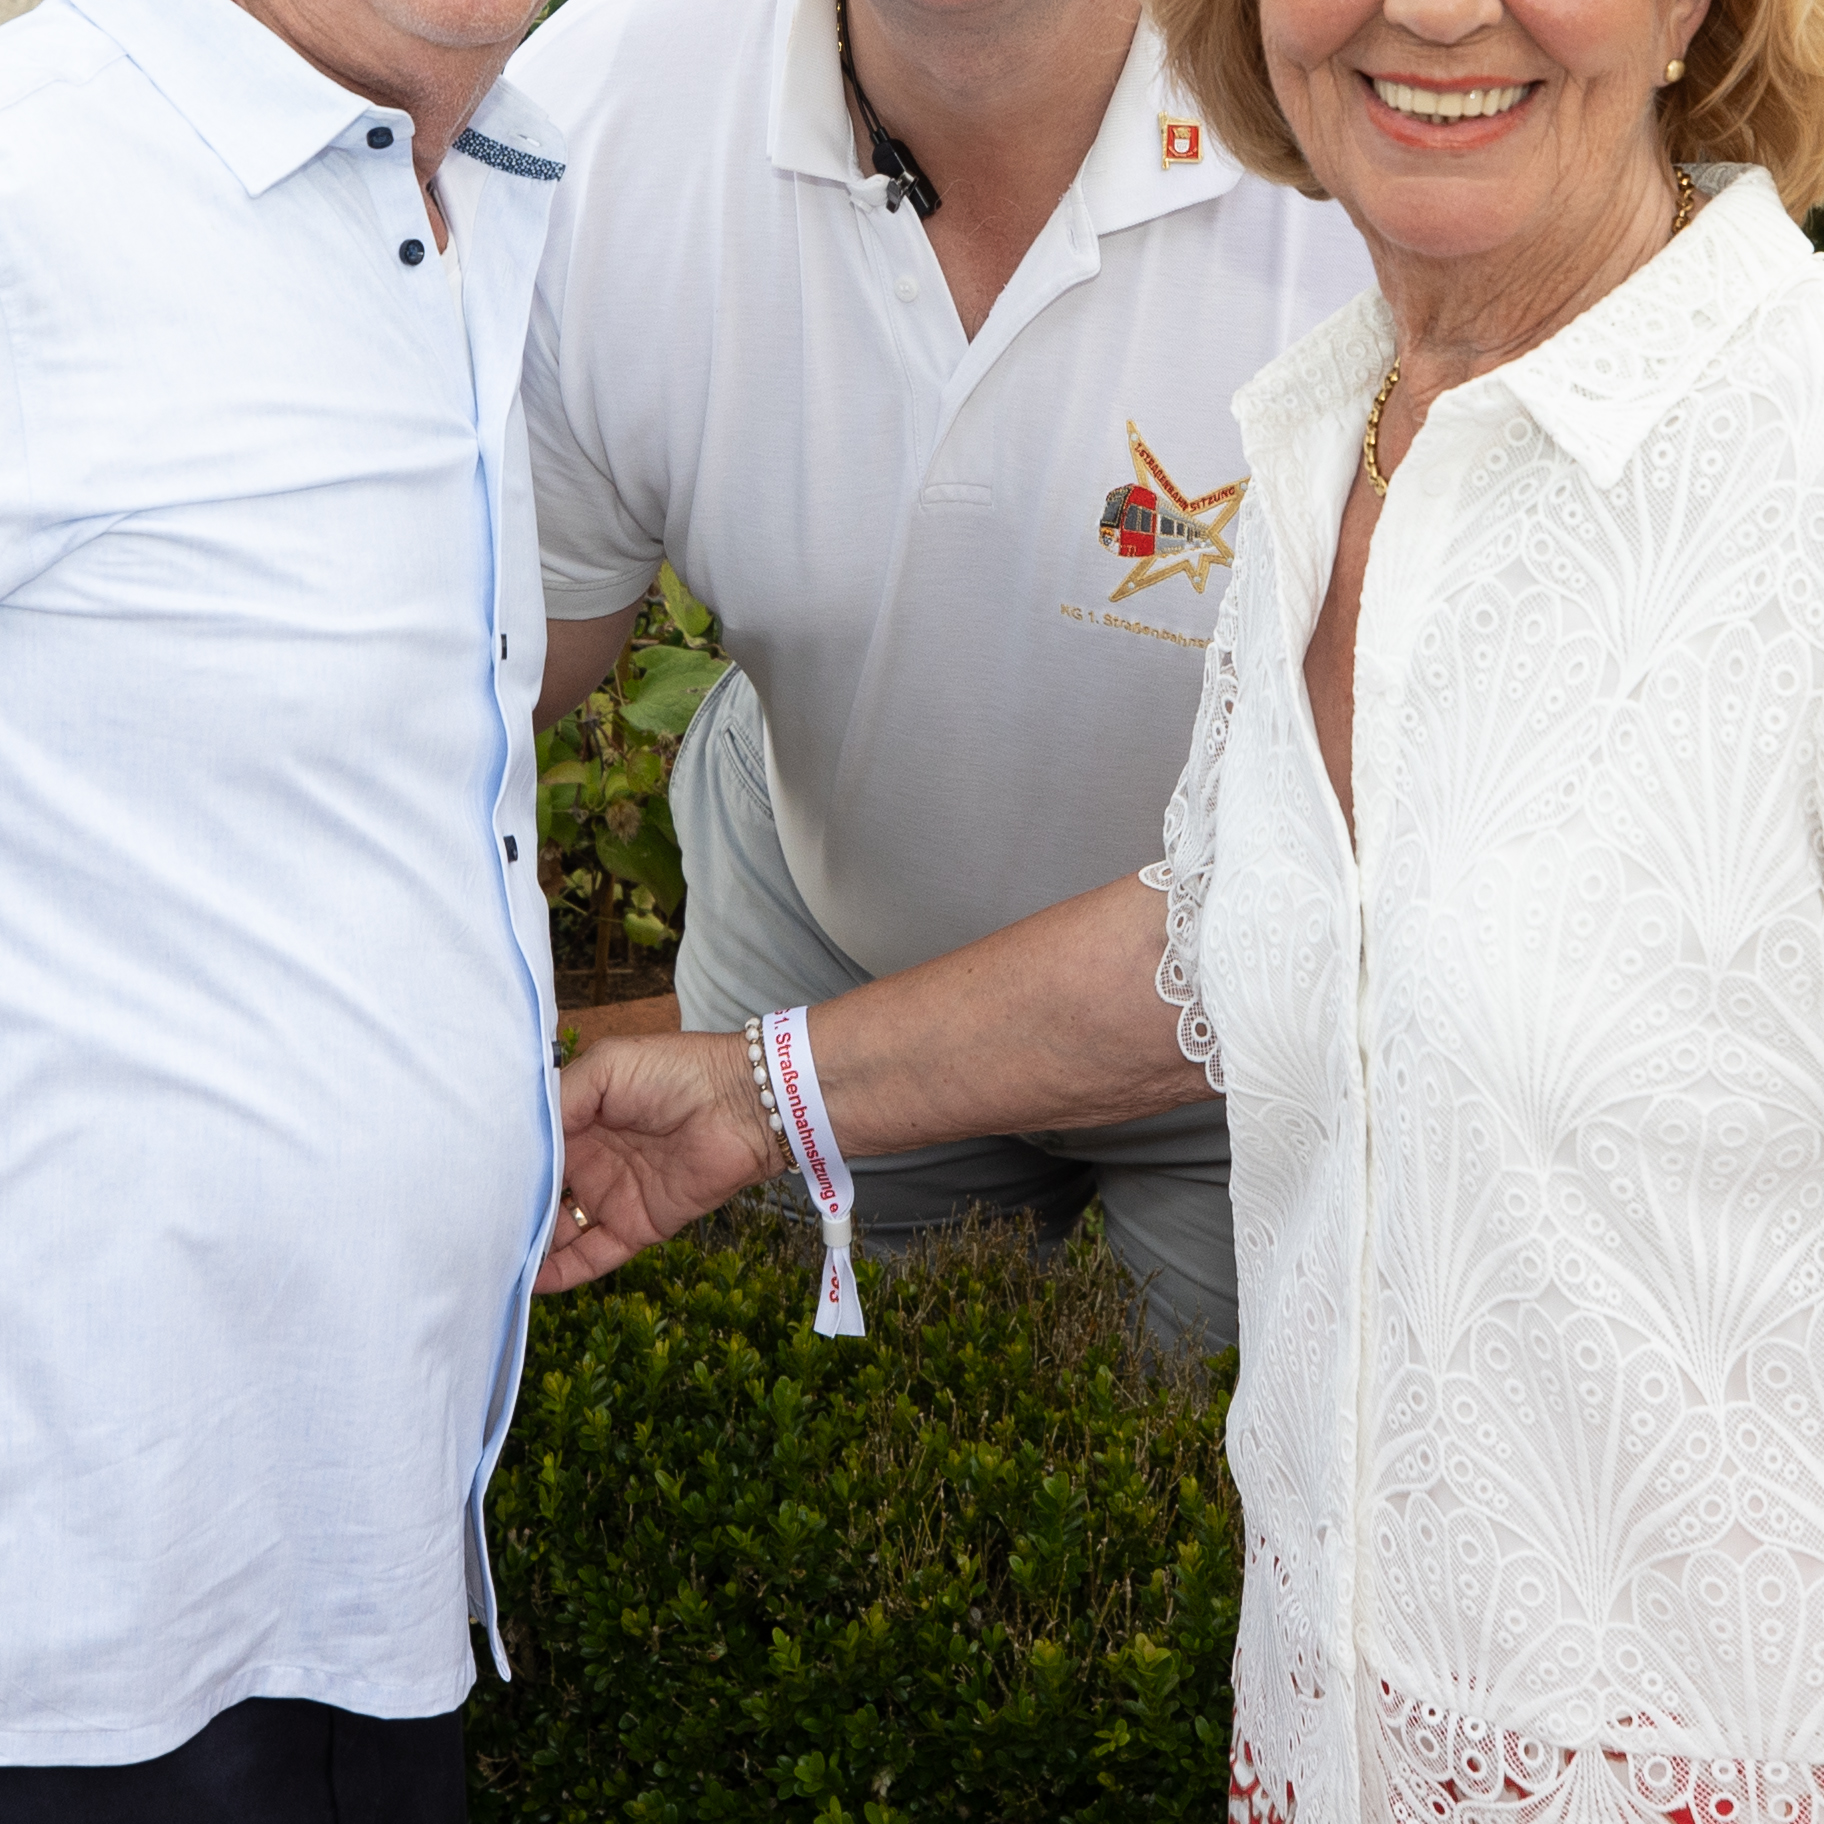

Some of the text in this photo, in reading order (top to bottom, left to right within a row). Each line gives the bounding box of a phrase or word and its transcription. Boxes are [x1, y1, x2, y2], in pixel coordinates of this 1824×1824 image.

[1189, 486, 1236, 513] SITZUNG
[1060, 603, 1084, 622] KG
[1088, 610, 1100, 624] 1.
[775, 1032, 837, 1201] Straßenbahnsitzung
